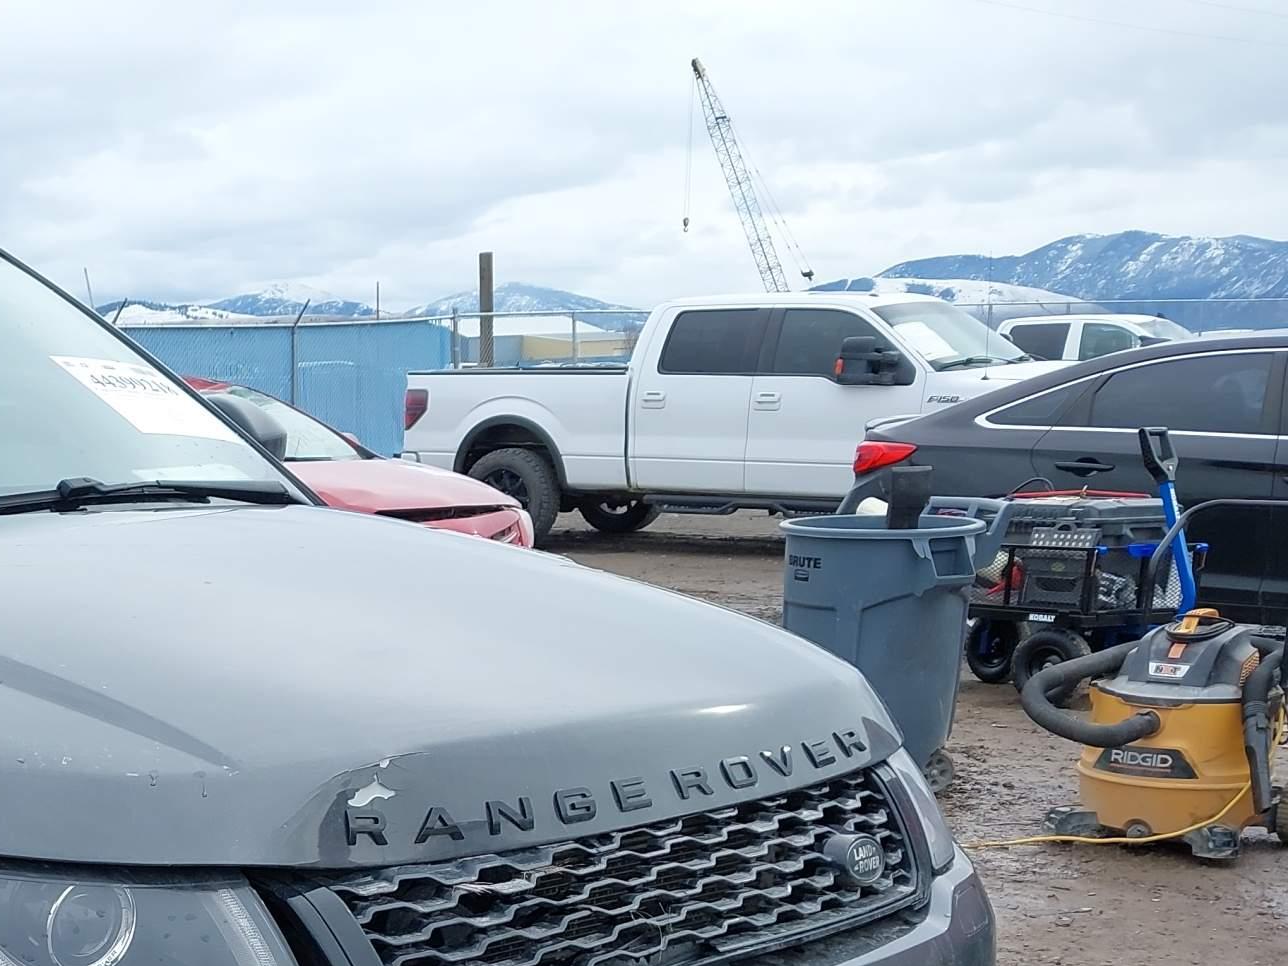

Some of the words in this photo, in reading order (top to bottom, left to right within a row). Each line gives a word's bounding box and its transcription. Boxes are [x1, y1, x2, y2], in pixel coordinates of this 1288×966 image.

[789, 554, 822, 569] BRUTE
[1111, 749, 1173, 768] RIDGID
[344, 776, 653, 847] RANGE
[671, 727, 868, 800] ROVER
[853, 844, 873, 861] LAND
[859, 855, 880, 873] ROVER
